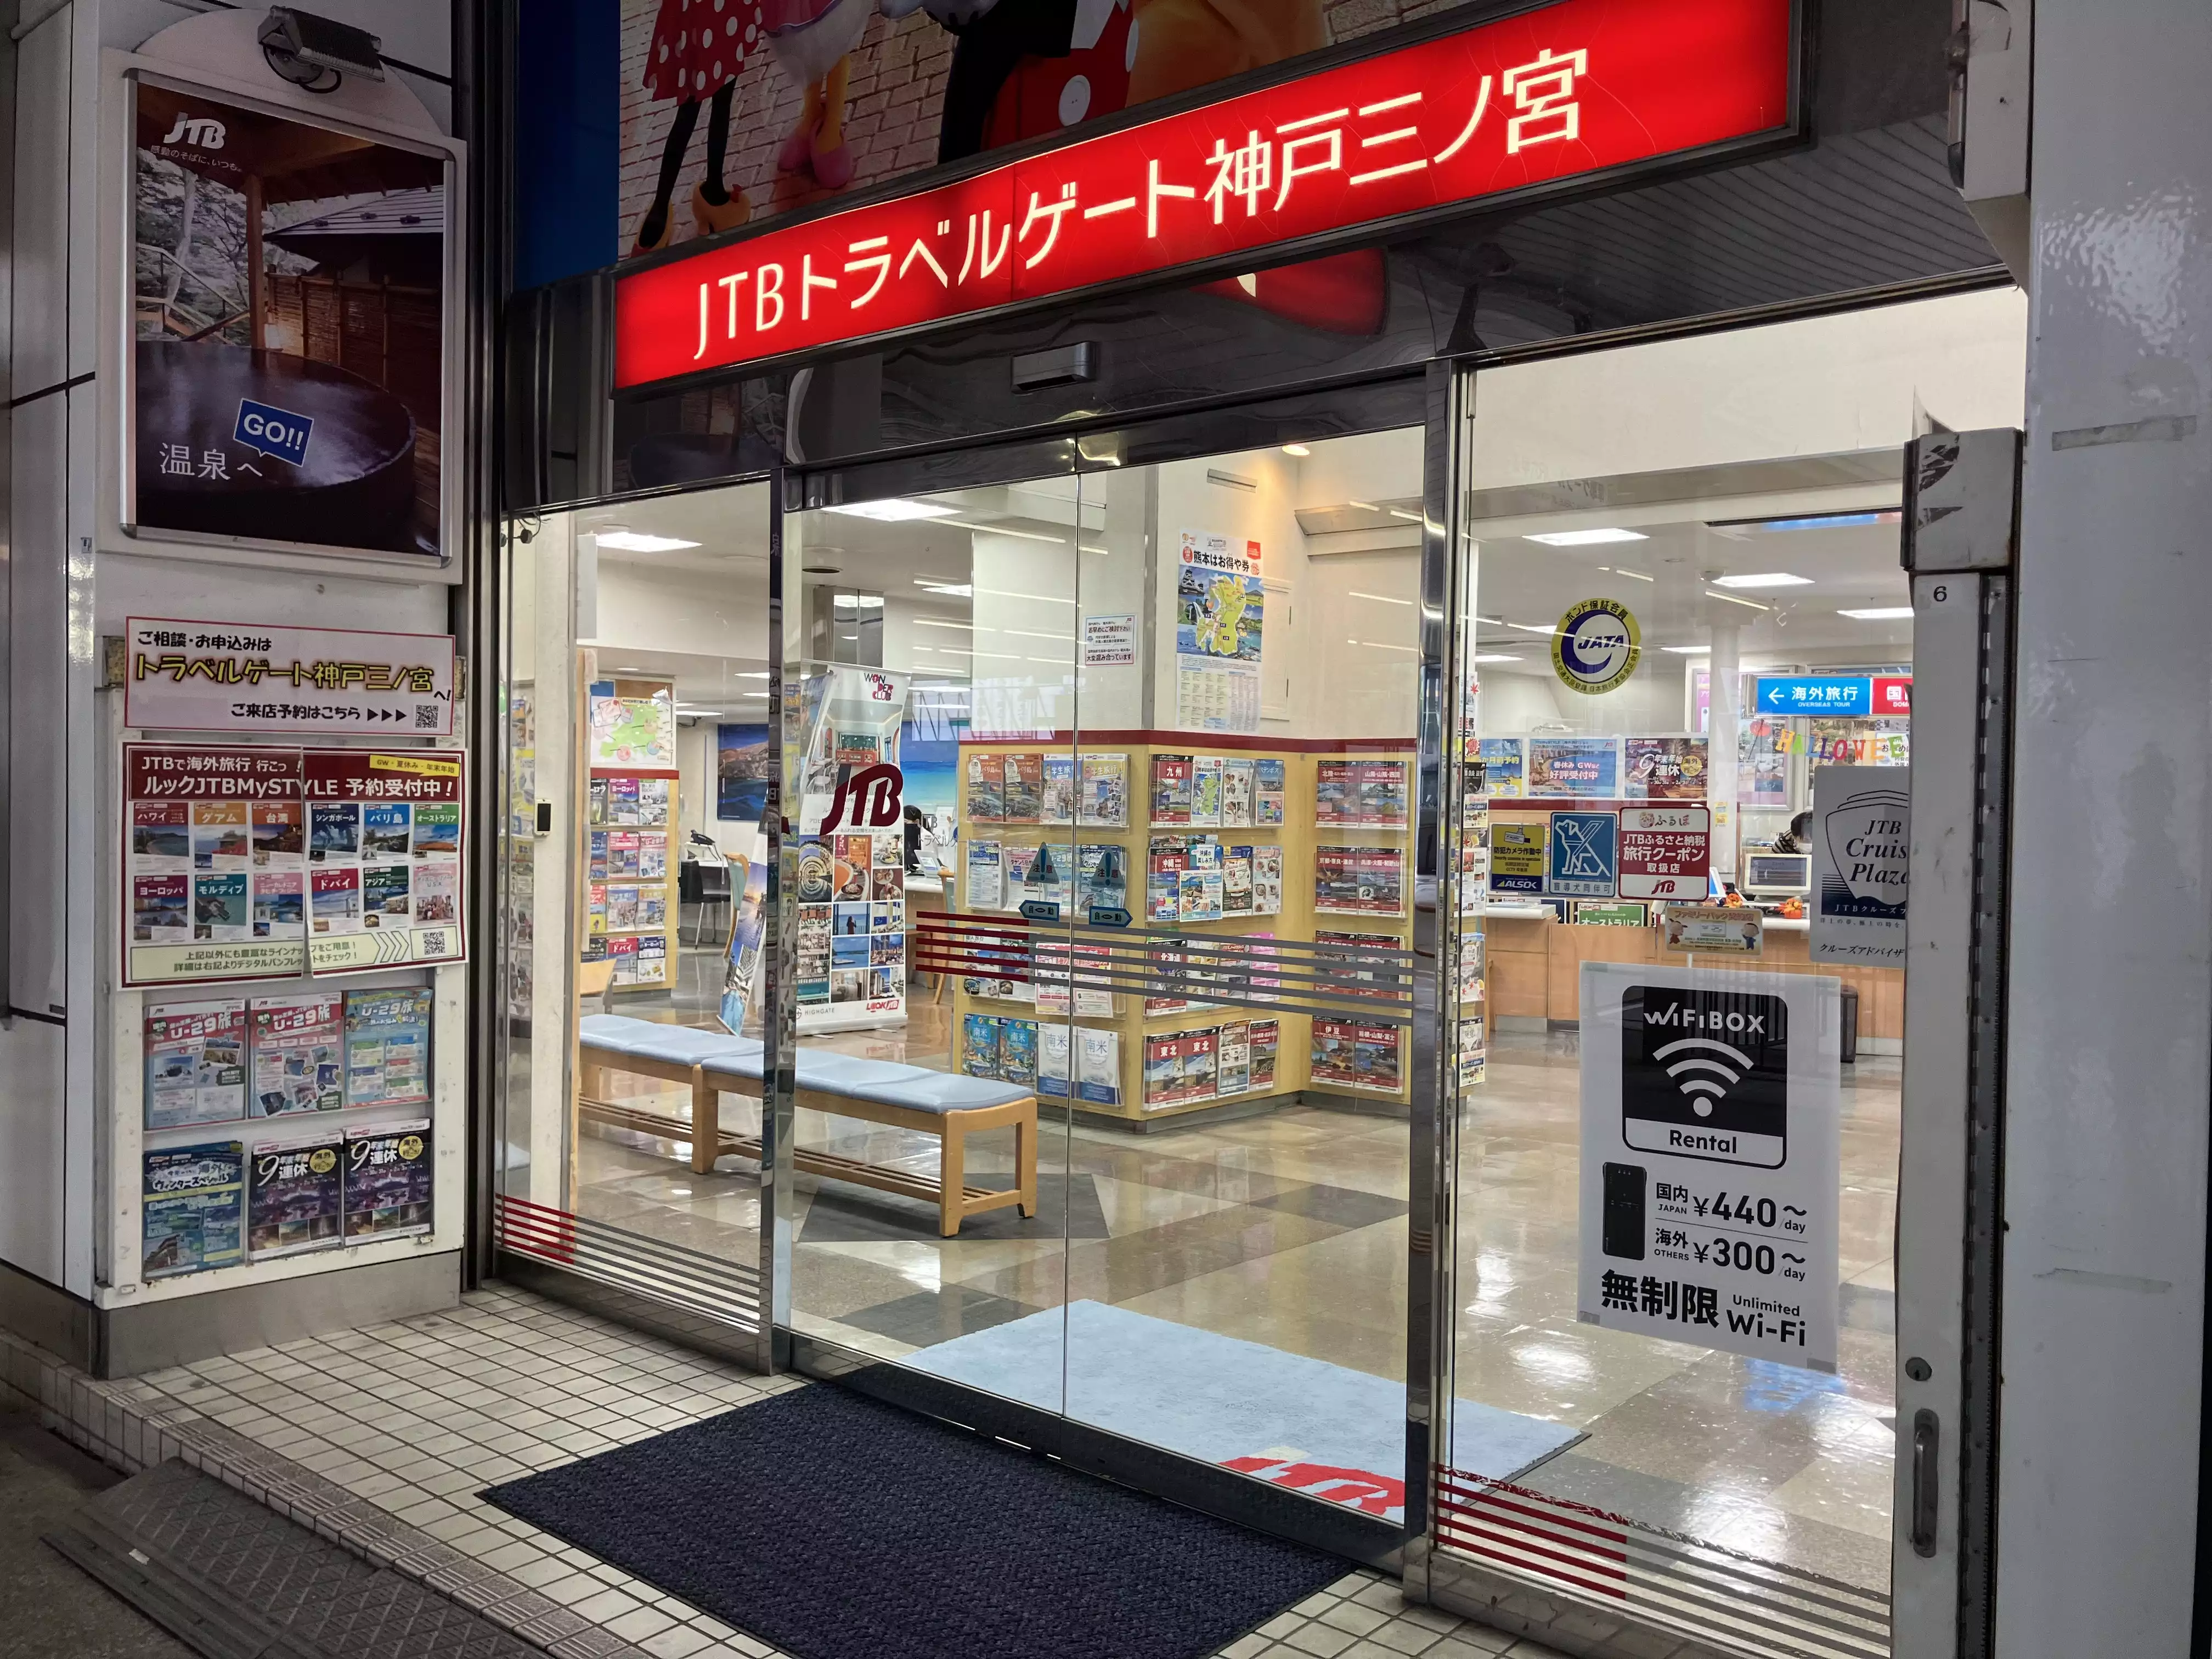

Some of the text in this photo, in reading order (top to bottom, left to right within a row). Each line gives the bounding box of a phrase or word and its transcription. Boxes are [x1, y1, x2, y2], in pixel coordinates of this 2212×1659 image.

[163, 111, 226, 149] JTB
[150, 145, 242, 172] 感動のそばに、いつも。
[693, 48, 1587, 360] JTBトラベルゲート神戸三ノ宮
[244, 413, 304, 451] GO!!
[159, 442, 263, 481] 温泉へ
[1194, 550, 1250, 572] 熊本はお得や券
[1933, 586, 1948, 602] 6
[1565, 600, 1629, 623] ボンド保証会員
[137, 630, 272, 651] ご相談・お申込みは
[1578, 635, 1624, 650] JATA
[135, 653, 435, 692] トラベルゲート神戸三ノ宮
[872, 691, 891, 701] CLUB
[1791, 686, 1858, 701] 海外旅行
[230, 703, 360, 720] ご来店予約はこちら
[141, 756, 251, 772] JTBで海外旅行
[1655, 754, 1683, 764] 年末年始
[1166, 766, 1182, 777] 九州
[1549, 770, 1598, 780] 好評受付中
[1656, 764, 1680, 776] 連休
[819, 763, 904, 836] JTB
[137, 812, 167, 822] ハワイ
[201, 812, 237, 823] グアム
[416, 814, 457, 822] オーストラリア
[1864, 820, 1901, 835] JTB
[1623, 833, 1706, 847] JTBふるさと納税
[1493, 847, 1542, 856] 防犯カメラ作動中
[1623, 845, 1705, 862] 旅行クーポン
[1646, 862, 1680, 873] 取扱店
[198, 883, 245, 895] モルディブ
[320, 878, 351, 891] ドバイ
[365, 878, 385, 887] アジア
[1504, 880, 1537, 889] ALSOK
[1554, 882, 1611, 894] 盲導犬同伴可
[1651, 879, 1675, 895] JTB
[140, 885, 184, 896] ヨーロッパ
[613, 944, 632, 953] ドバイ
[805, 1007, 835, 1015] HIGHGATE
[973, 1027, 988, 1037] 南米
[1010, 1032, 1025, 1042] 南米
[1325, 1025, 1340, 1035] 伊豆
[1046, 1034, 1068, 1048] 南米
[1086, 1039, 1108, 1054] 南米
[1193, 1040, 1210, 1052] 東北
[1160, 1045, 1178, 1057] 東北
[1669, 1128, 1737, 1155] Rental
[370, 1149, 398, 1165] 連休
[279, 1164, 308, 1180] 連休
[1656, 1182, 1689, 1204] 国内
[1658, 1203, 1688, 1215] JAPAN
[1655, 1227, 1689, 1250] 海外
[1654, 1249, 1690, 1261] OTHERS
[1601, 1268, 1720, 1329] 無制限
[1732, 1294, 1801, 1317] Unlimited
[1726, 1308, 1805, 1347] Wi-Fi
